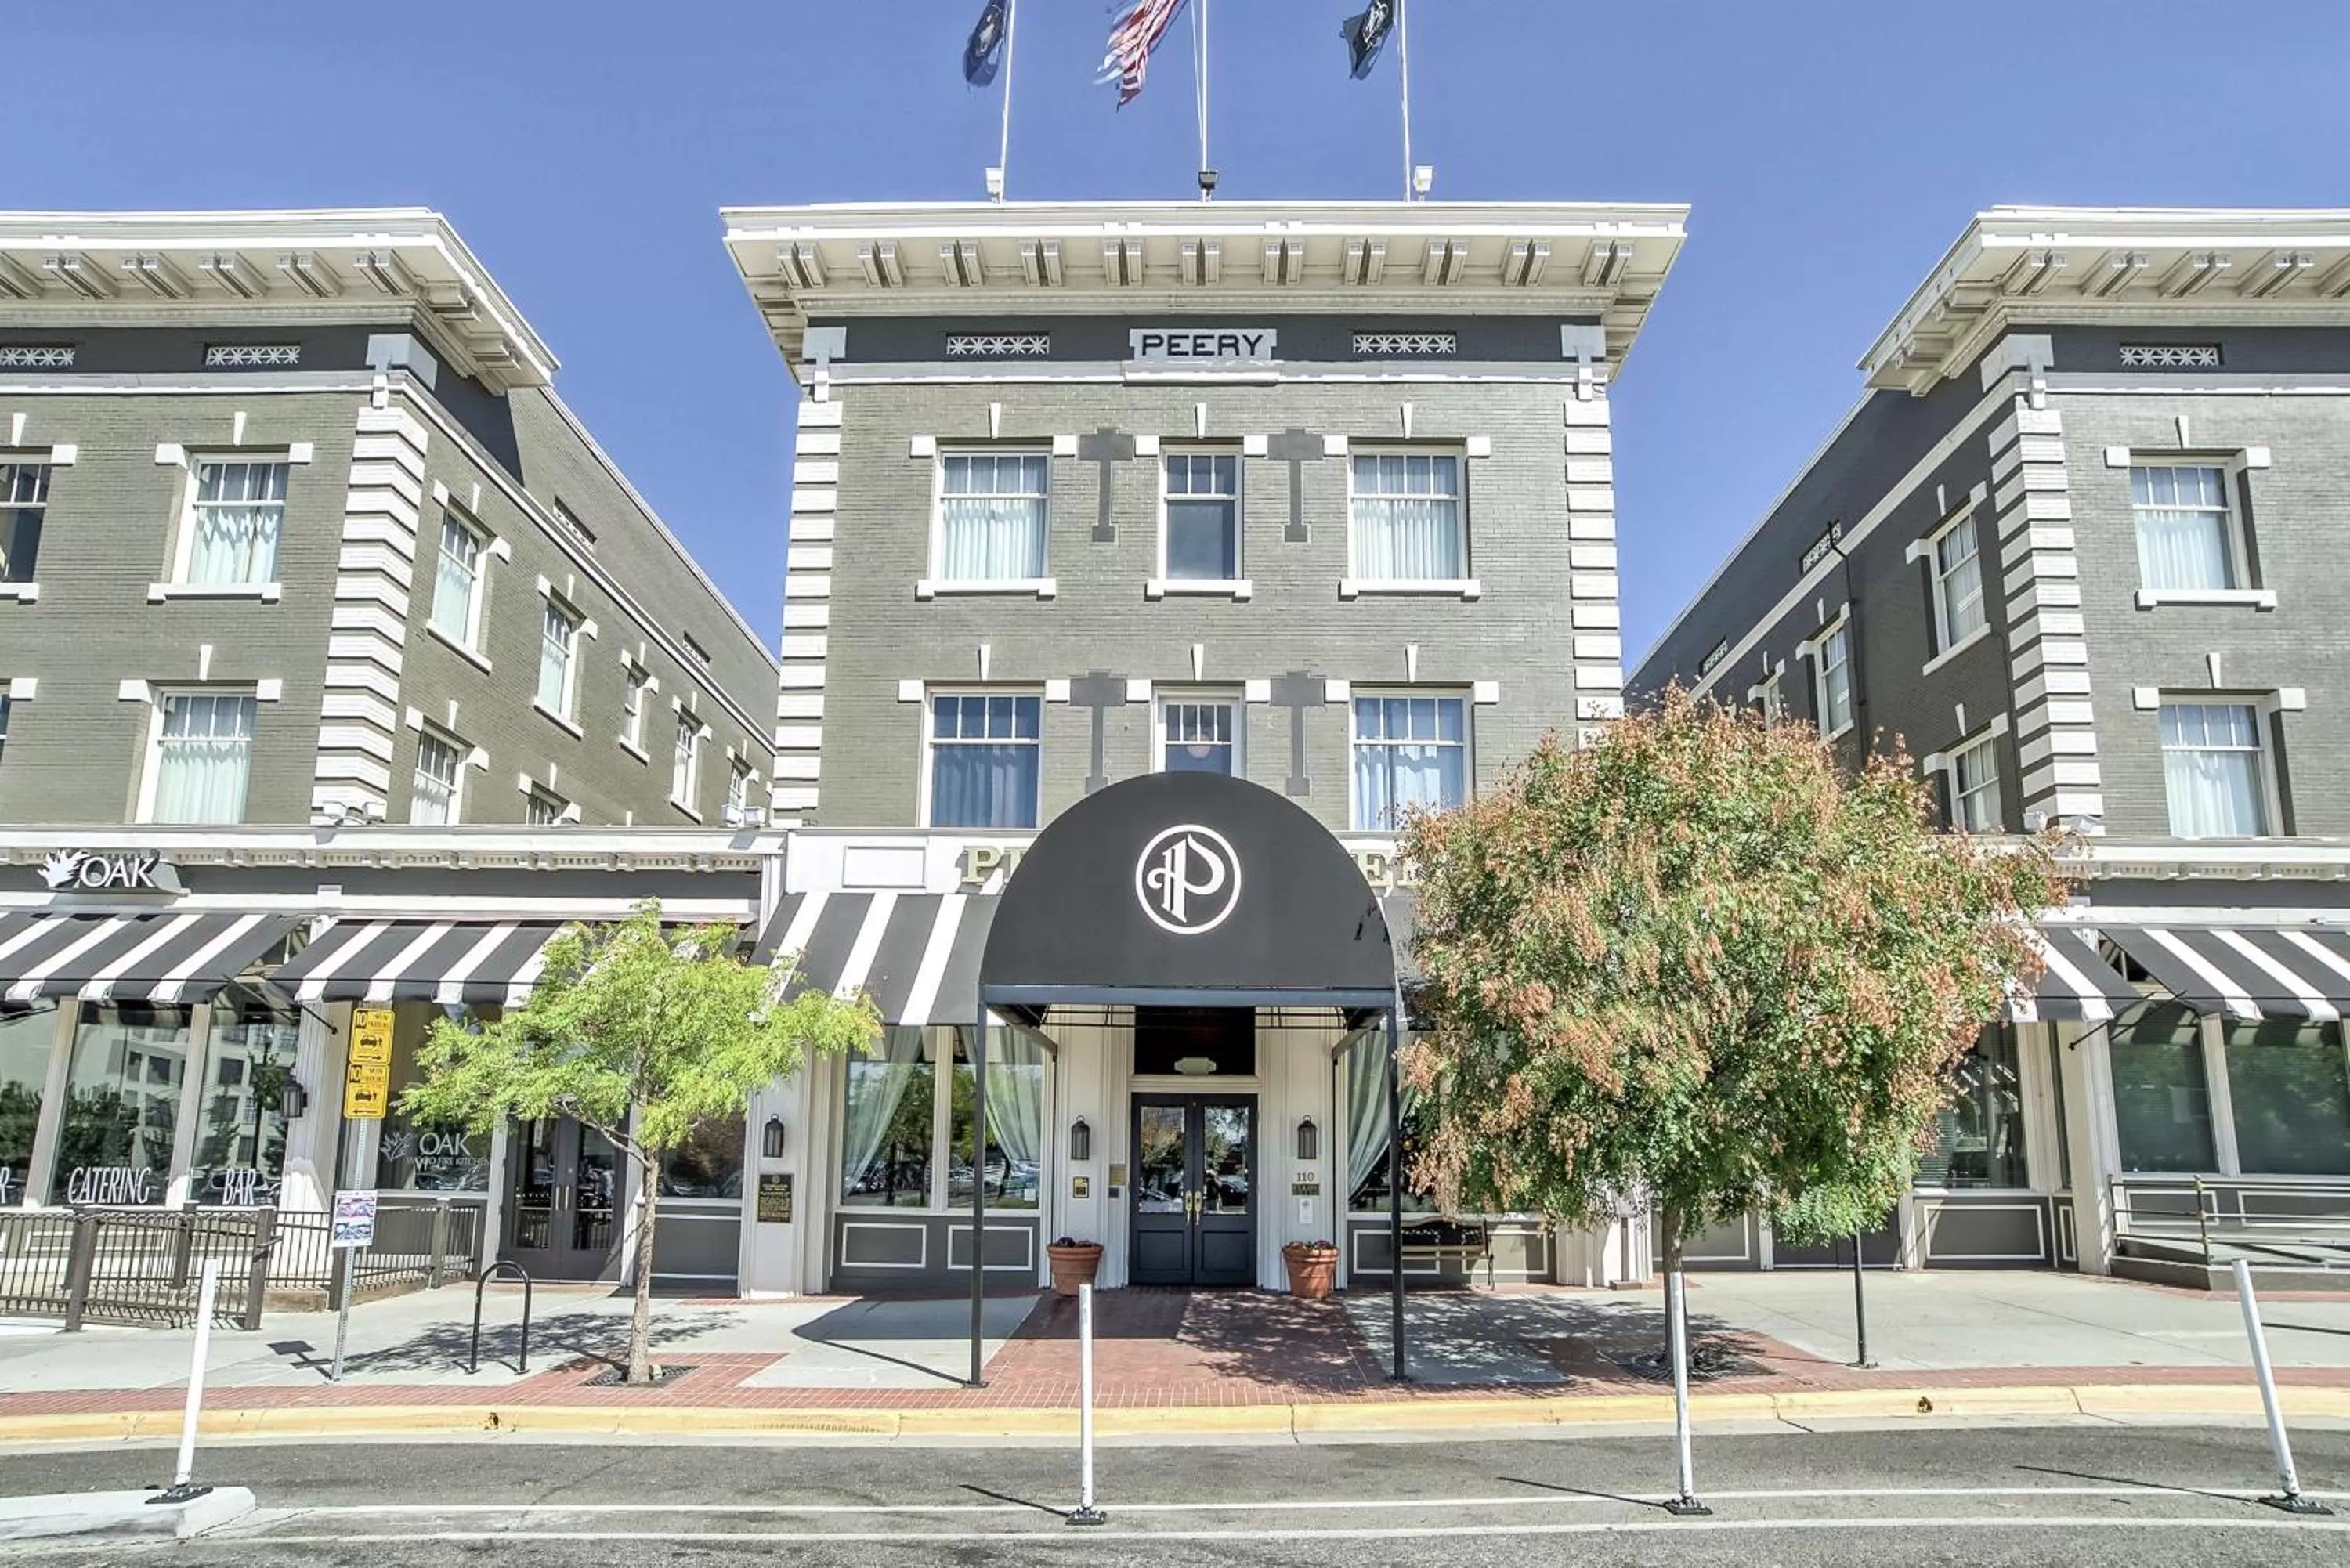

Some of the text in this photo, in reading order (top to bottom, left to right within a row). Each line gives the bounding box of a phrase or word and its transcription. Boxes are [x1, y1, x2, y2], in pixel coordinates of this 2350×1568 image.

[1141, 334, 1264, 356] PEERY
[80, 857, 155, 887] OAK
[356, 1011, 367, 1027] 10
[350, 1066, 361, 1081] 10
[419, 1132, 471, 1156] OAK
[68, 1166, 152, 1205] CATERING
[222, 1168, 257, 1205] BAR
[1296, 1171, 1315, 1182] 110
